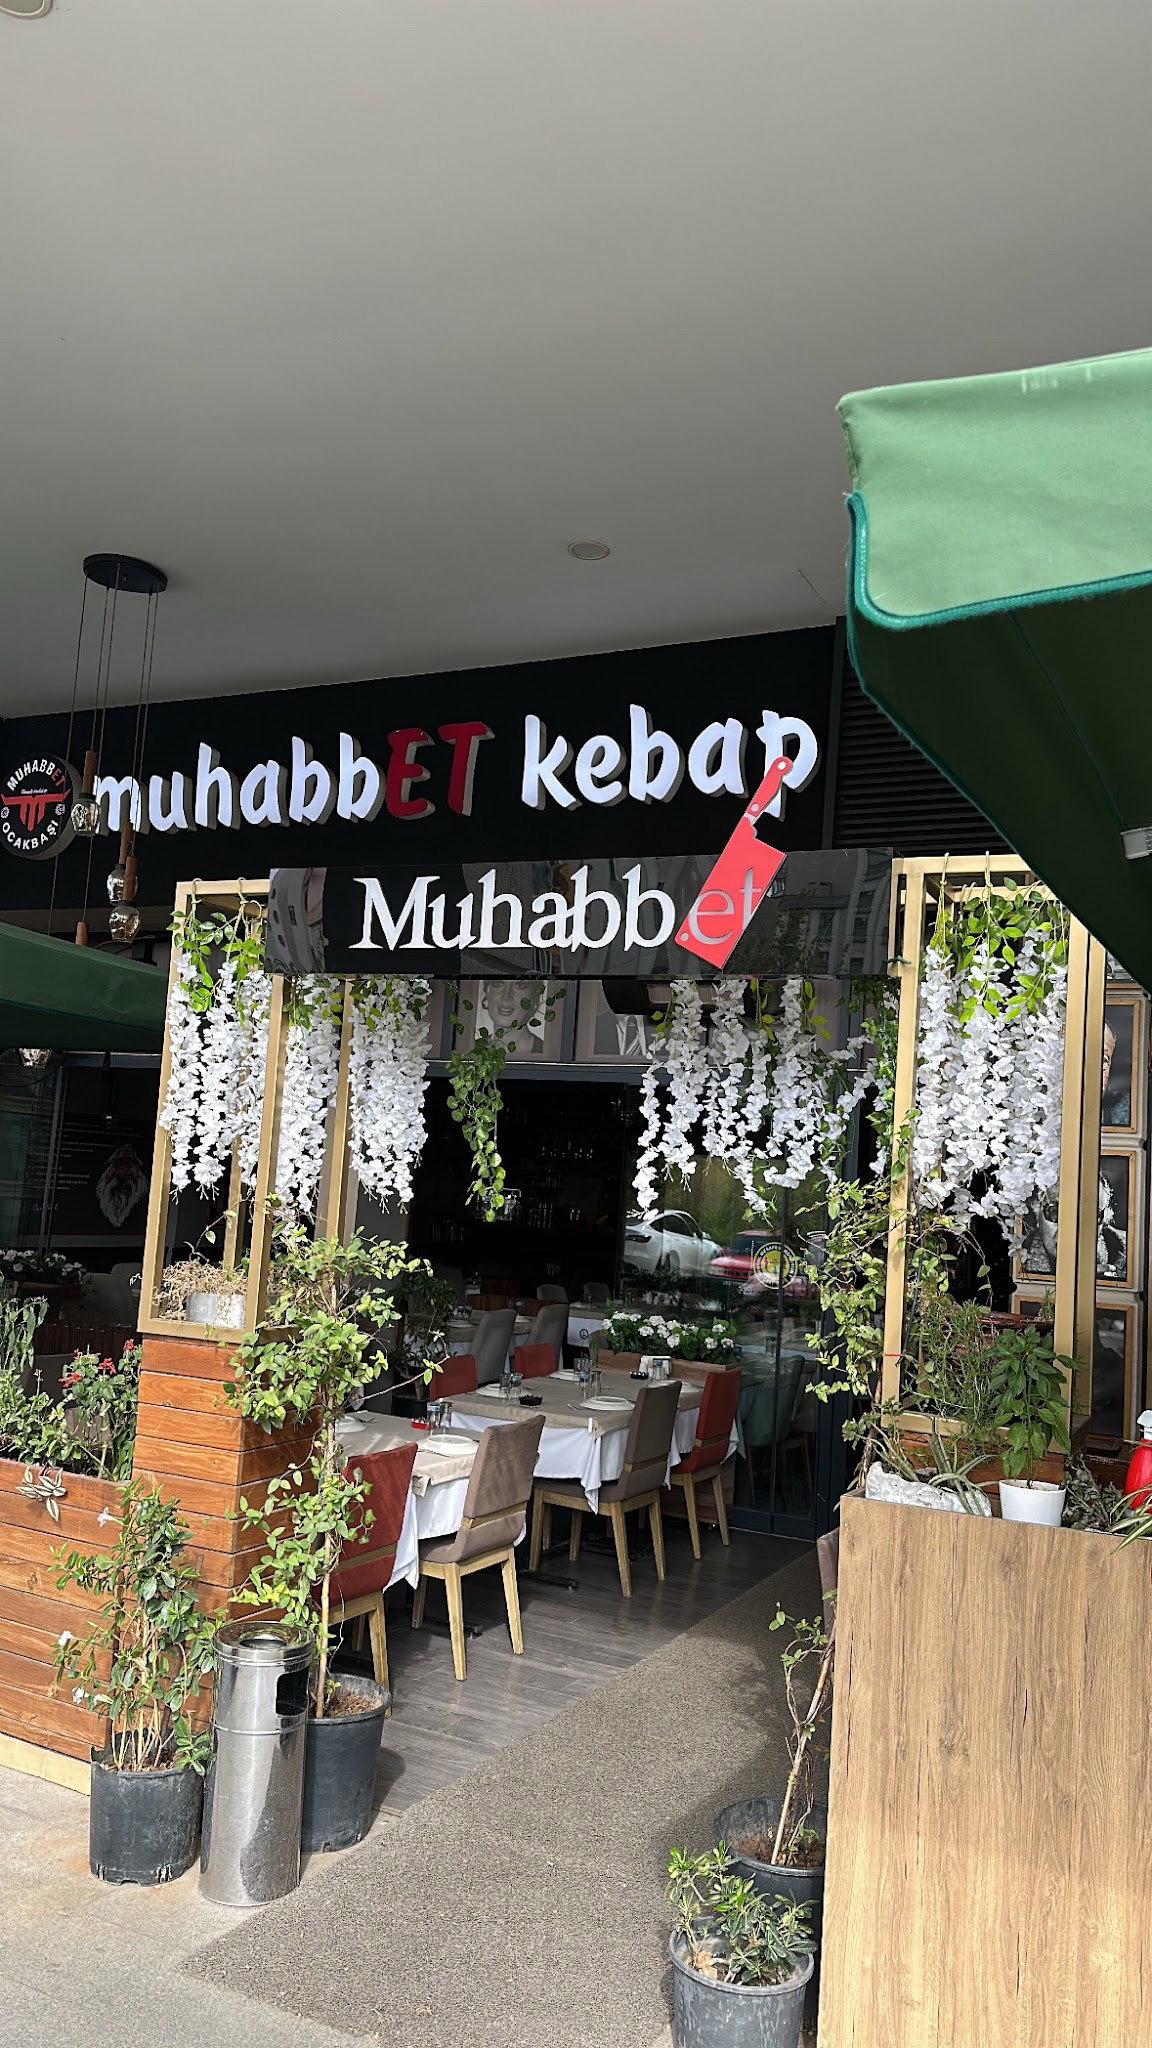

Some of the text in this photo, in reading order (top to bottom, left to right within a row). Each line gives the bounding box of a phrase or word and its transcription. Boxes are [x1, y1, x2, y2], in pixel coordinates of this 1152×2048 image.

[7, 759, 66, 792] MUHABBET
[94, 703, 819, 833] muhabbET kebap
[2, 819, 59, 850] OCAKBAŞI
